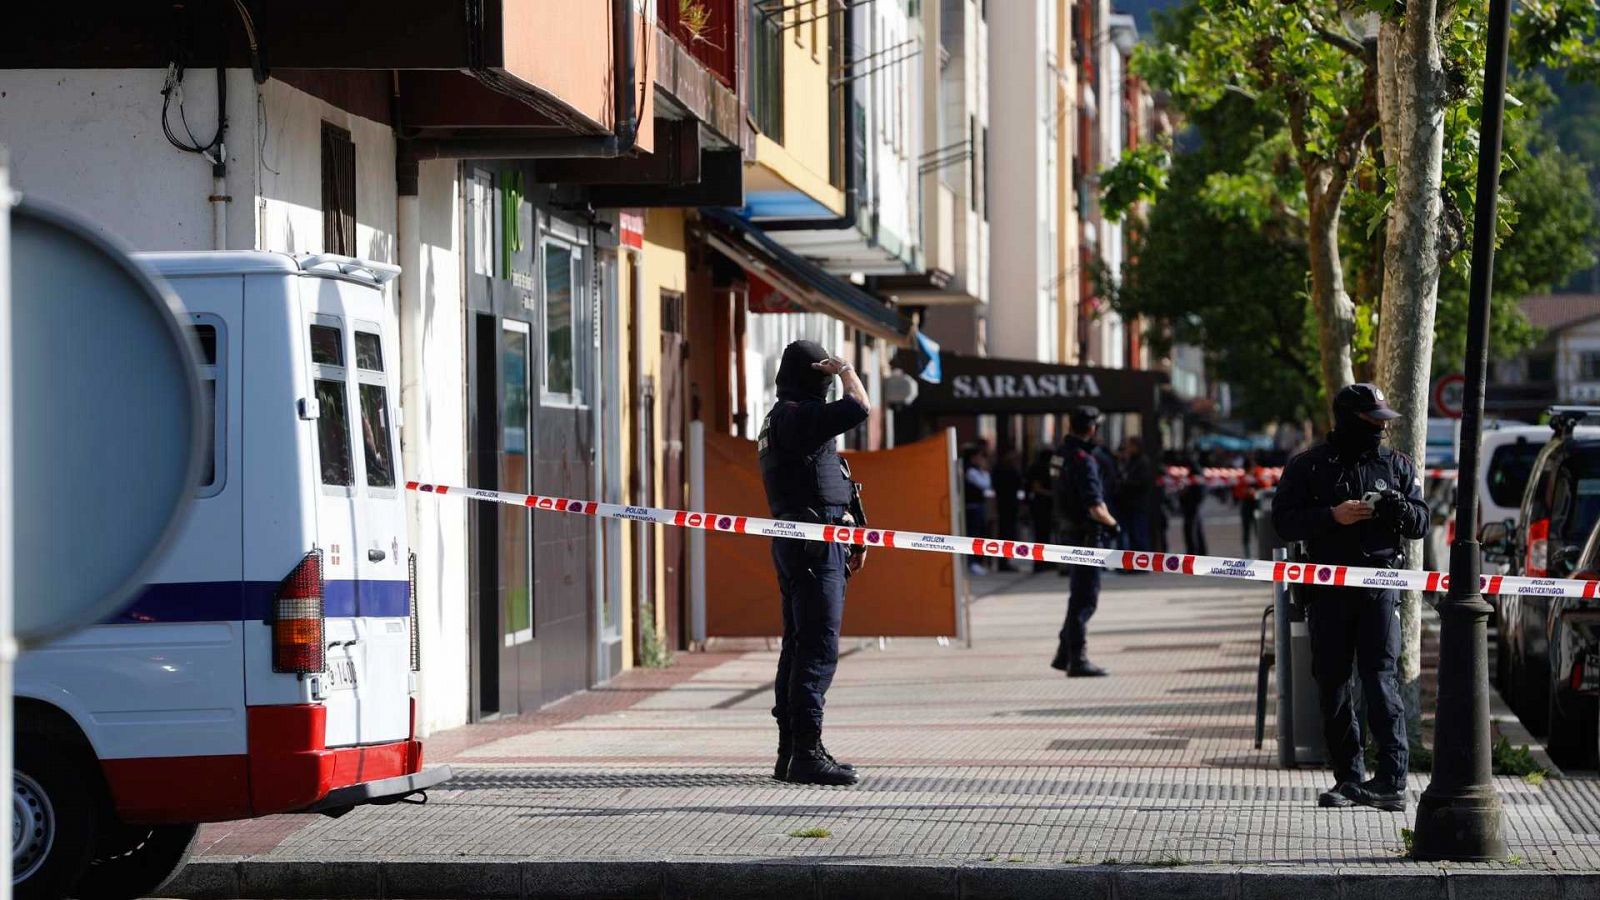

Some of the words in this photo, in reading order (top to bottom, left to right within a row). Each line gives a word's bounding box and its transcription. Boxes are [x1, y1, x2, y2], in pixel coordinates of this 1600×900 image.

[952, 374, 1100, 398] SARASUA
[625, 506, 648, 515] POLIZIA
[773, 521, 796, 530] POLIZIA
[921, 535, 945, 543] POLIZIA
[1222, 560, 1246, 568] POLIZIA
[1211, 567, 1256, 577] UDALTZAINGOA
[1375, 570, 1399, 578] POLIZIA
[1362, 578, 1408, 587] UDALTZAINGOA
[1518, 586, 1565, 595] UDALTZAINGOA
